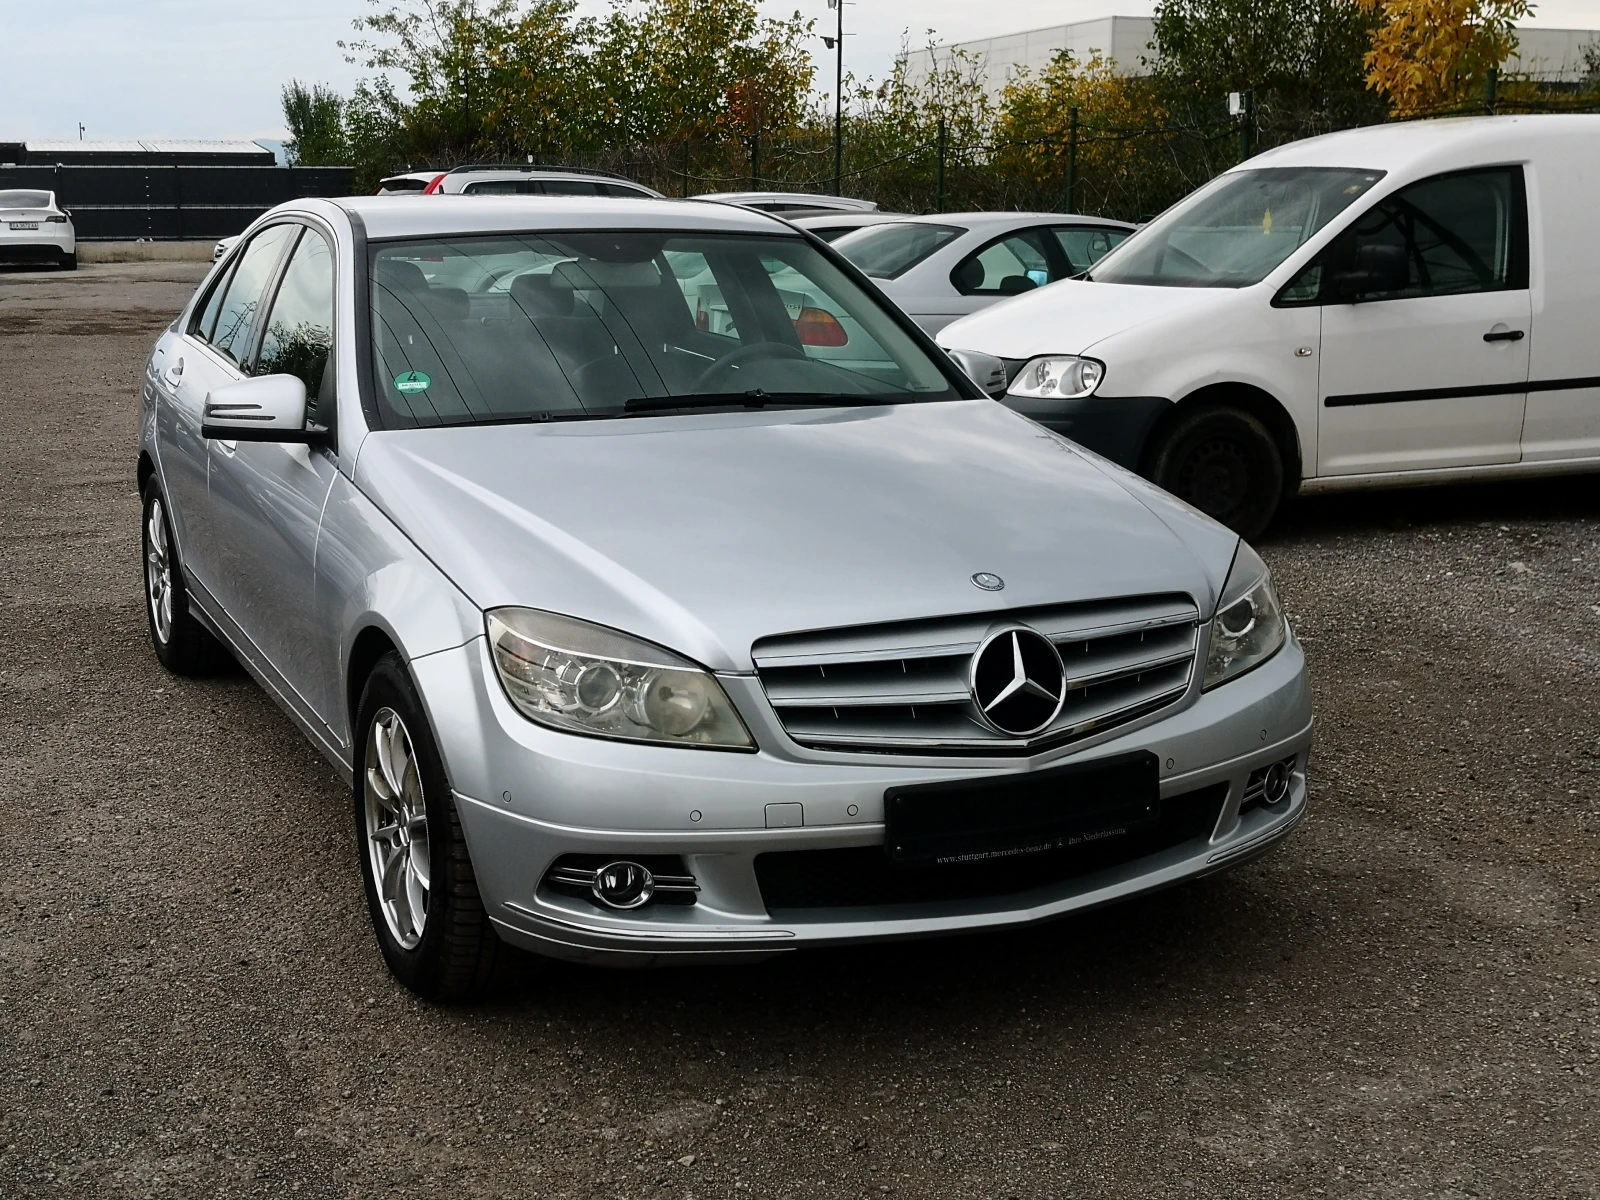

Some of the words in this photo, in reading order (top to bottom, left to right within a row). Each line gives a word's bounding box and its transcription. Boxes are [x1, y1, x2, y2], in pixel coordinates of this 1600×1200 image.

[407, 371, 418, 382] 4
[936, 843, 1052, 864] www.stuttgart.mercedes-benz.de
[1083, 827, 1126, 842] Niederlassung
